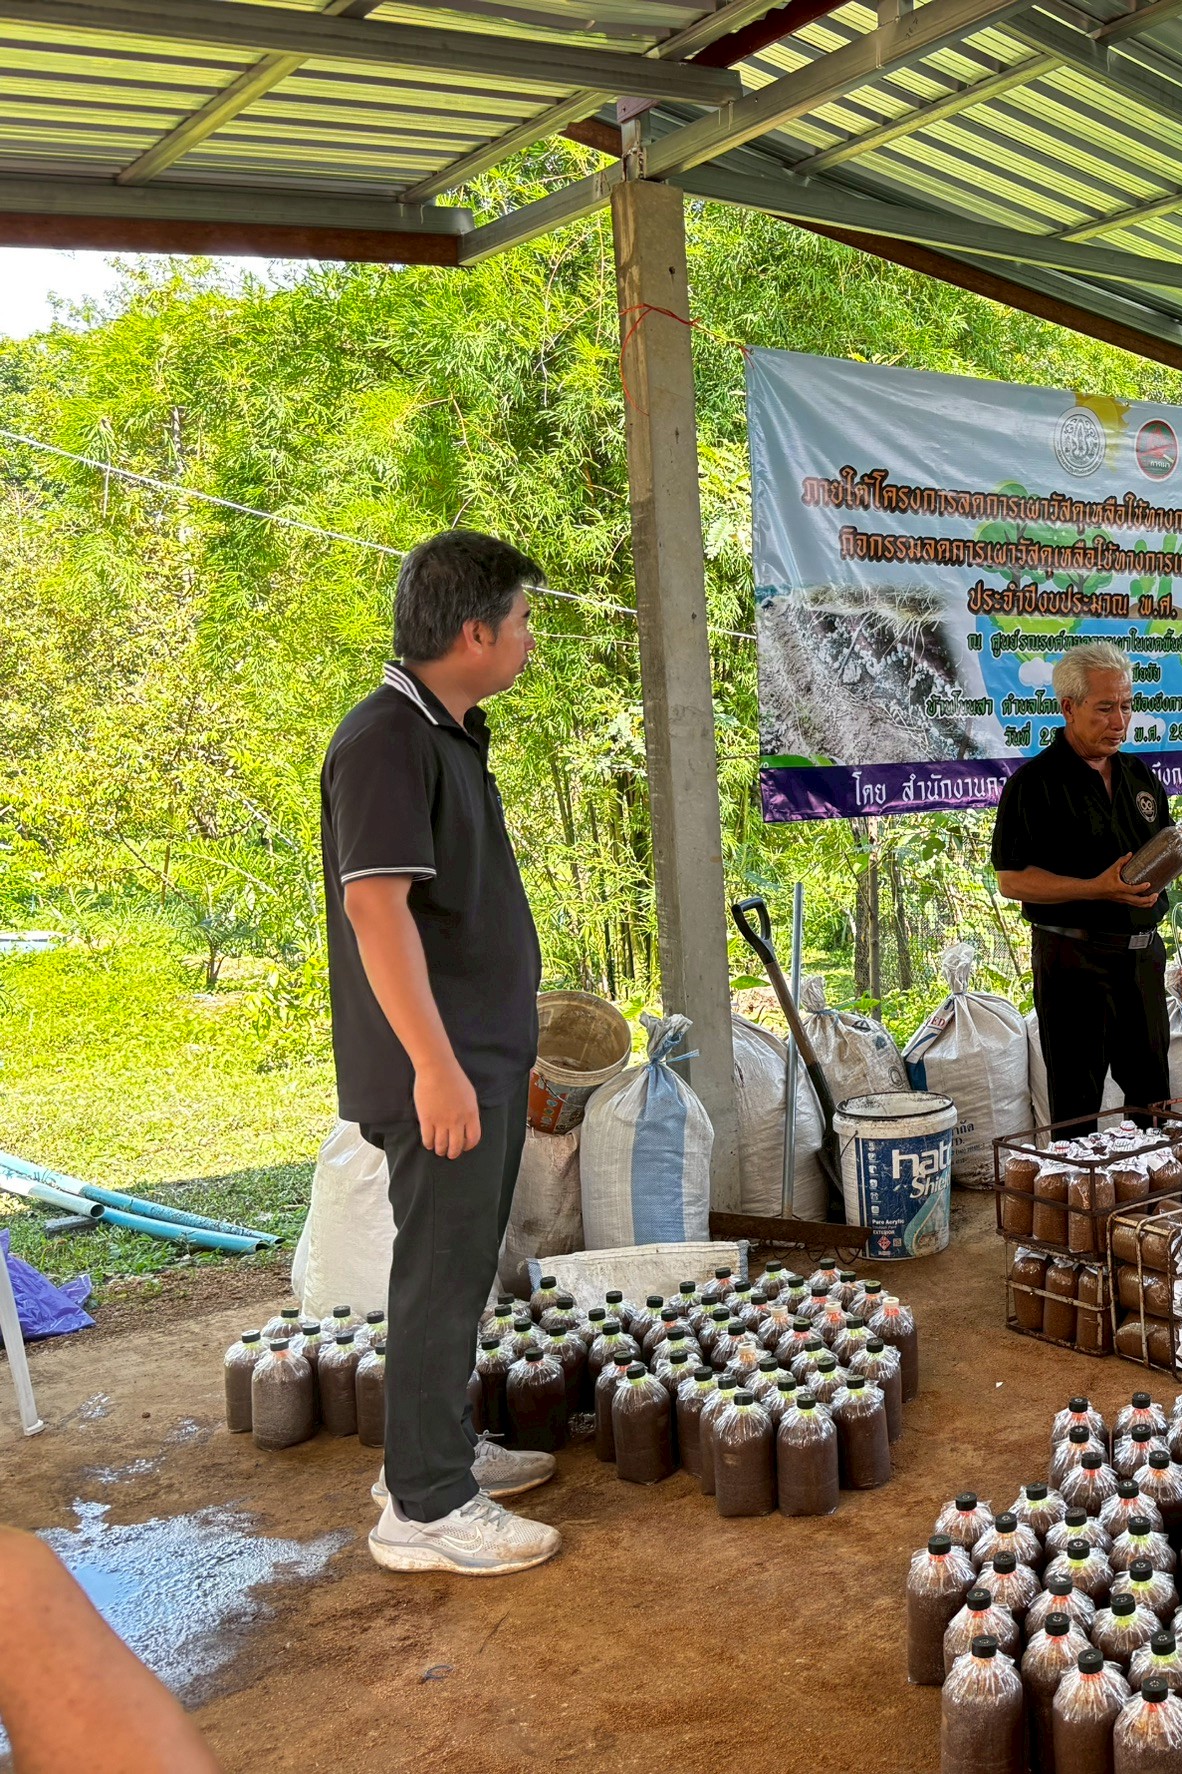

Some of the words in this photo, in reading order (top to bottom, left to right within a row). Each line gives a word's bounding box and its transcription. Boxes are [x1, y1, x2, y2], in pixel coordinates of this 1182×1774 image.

[967, 579, 1129, 616] ประจำปีงบประมาณ
[1139, 593, 1177, 619] พ.ศ.
[967, 633, 983, 650] ณ
[1002, 690, 1063, 715] ตำบลโคก
[1004, 721, 1031, 746] วันที่
[1134, 724, 1162, 742] พ.ศ.
[852, 772, 886, 806] โดย
[902, 773, 1007, 803] สำนักงานกา
